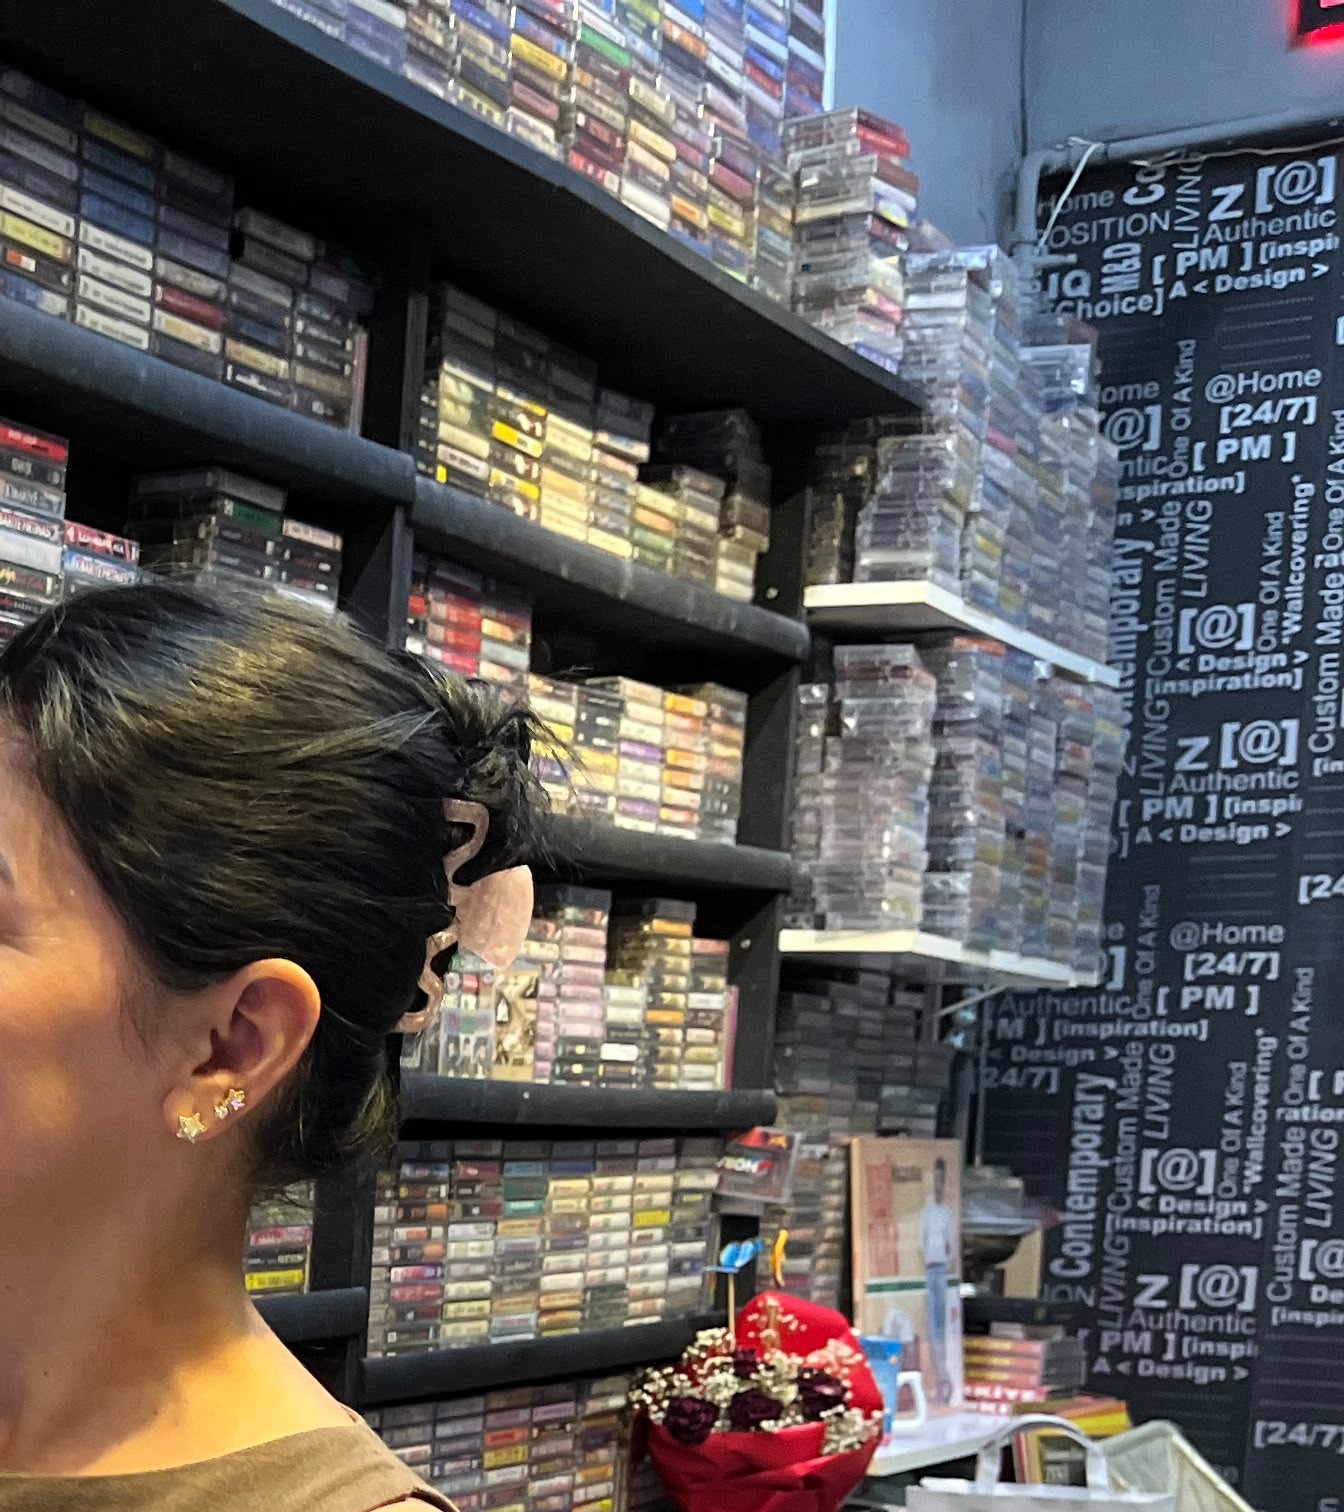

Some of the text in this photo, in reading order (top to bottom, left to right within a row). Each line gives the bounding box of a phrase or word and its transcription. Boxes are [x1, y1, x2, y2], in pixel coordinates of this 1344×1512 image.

[1204, 209, 1336, 244] Authentic
[1215, 267, 1304, 292] Design
[1205, 369, 1321, 403] @Home
[1220, 396, 1317, 433] [24/7]
[1182, 500, 1212, 597] LIVING
[1198, 653, 1287, 673] Design
[1175, 737, 1210, 771] Z
[1169, 771, 1299, 793] Authentic
[1180, 825, 1269, 845] Design
[1170, 922, 1285, 951] @Home
[1184, 953, 1279, 981] [24/7]
[1144, 1044, 1174, 1140] LIVING
[1307, 1129, 1339, 1228] LIVING
[1159, 1195, 1247, 1215] Design
[1134, 1275, 1168, 1308] Z
[1127, 1309, 1256, 1335] Authentic
